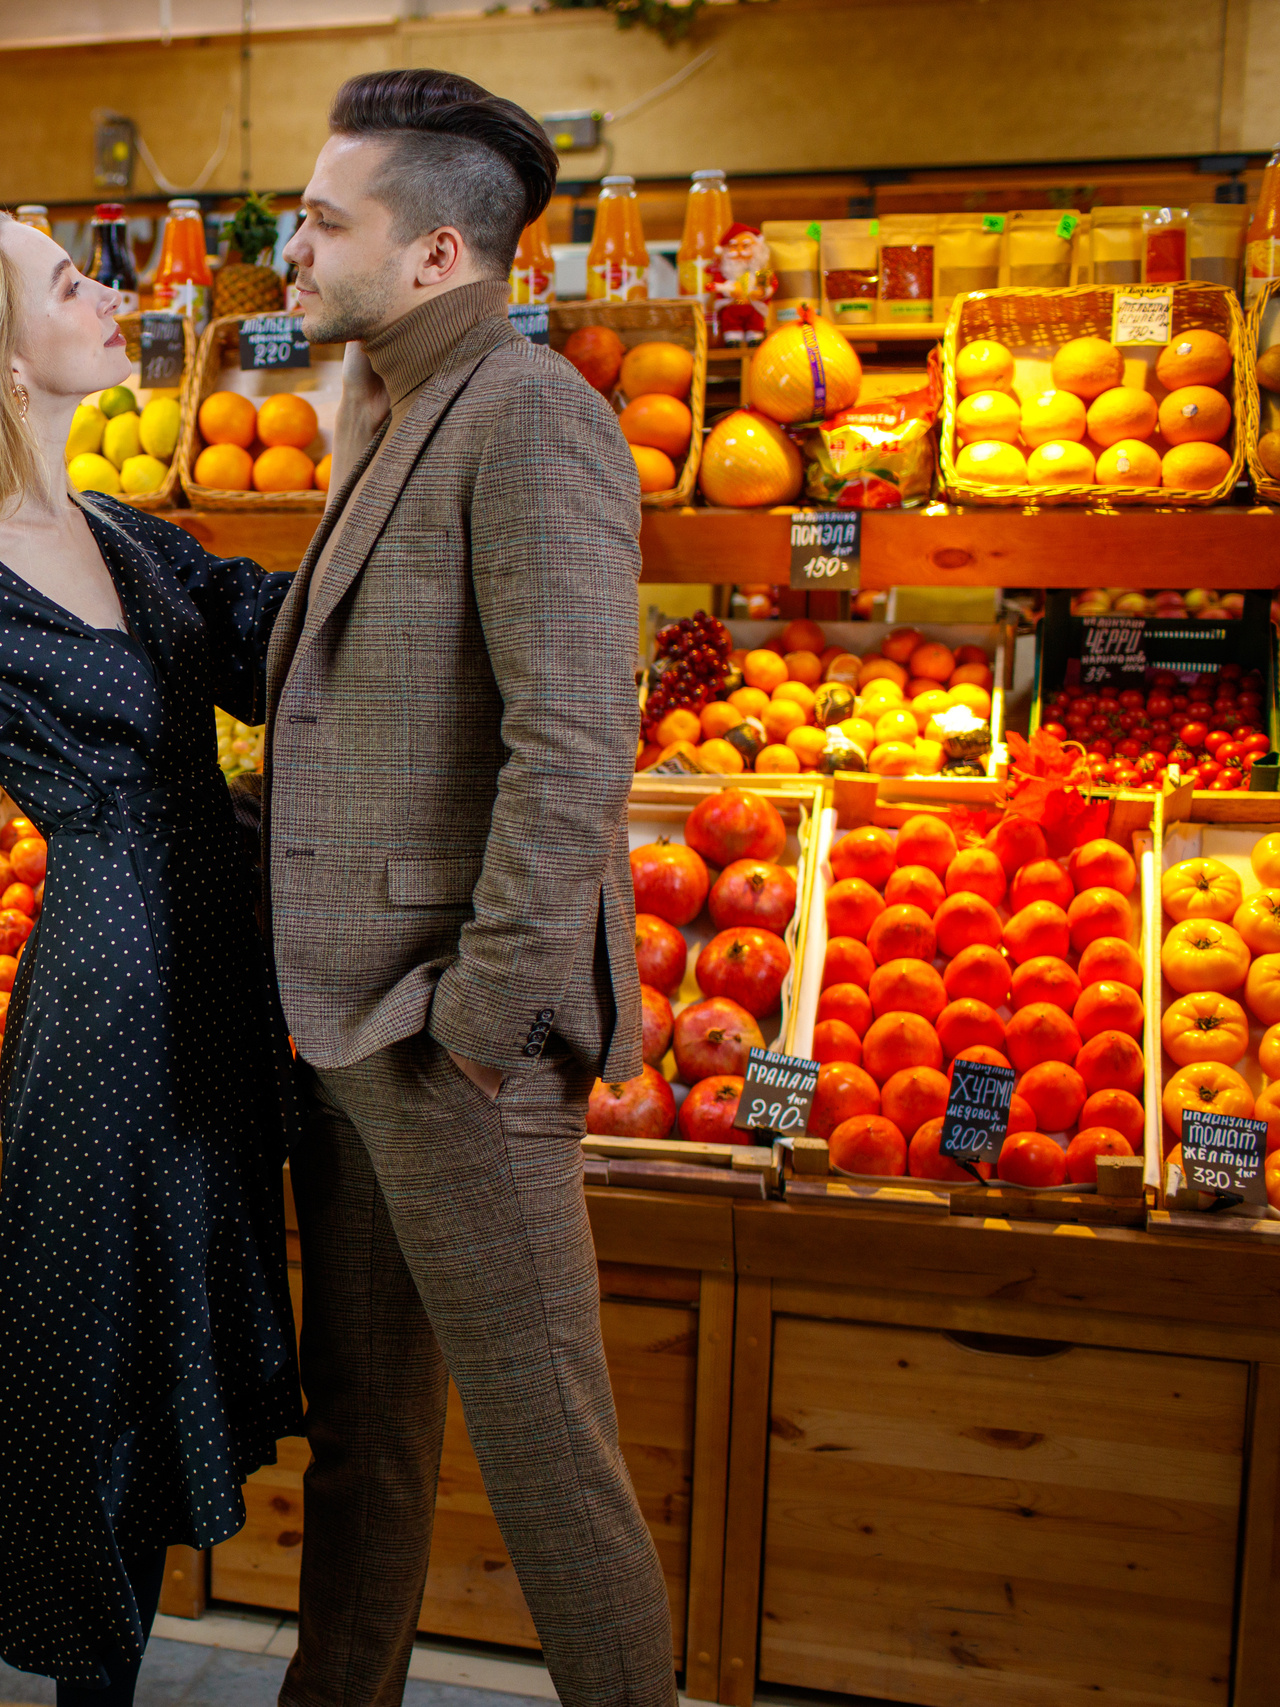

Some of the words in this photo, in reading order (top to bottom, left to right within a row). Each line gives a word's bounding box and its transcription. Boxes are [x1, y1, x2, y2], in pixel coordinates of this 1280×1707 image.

[1085, 628, 1141, 653] ЧЕРРИ
[746, 1062, 817, 1092] ГРАНАТ
[950, 1072, 1014, 1109] ХУРМА
[787, 1092, 808, 1105] 1кг
[1188, 1121, 1257, 1150] ТОМАТ
